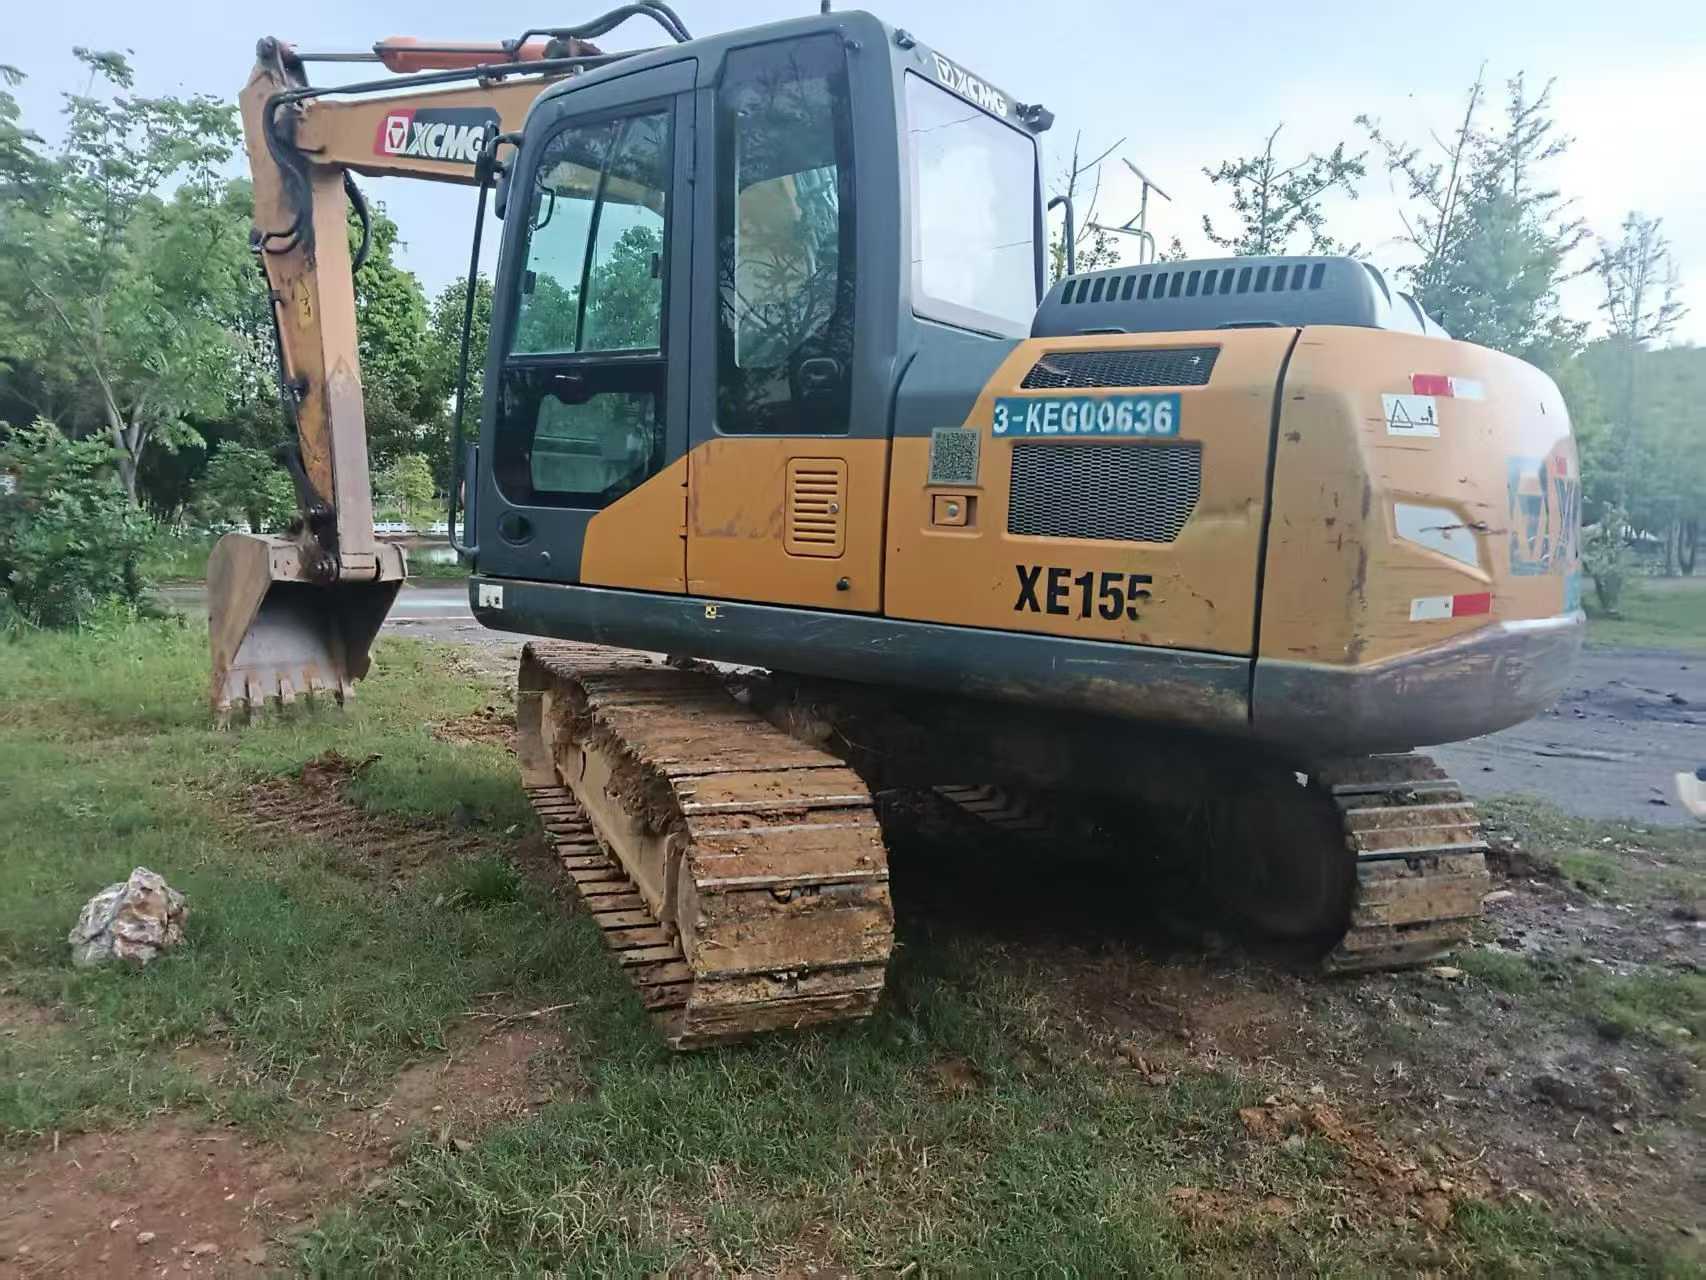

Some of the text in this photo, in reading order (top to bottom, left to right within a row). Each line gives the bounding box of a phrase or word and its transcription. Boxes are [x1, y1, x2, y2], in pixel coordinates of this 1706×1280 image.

[951, 66, 1008, 117] XCMG
[407, 122, 486, 162] XCMG
[993, 401, 1173, 433] 3-KEG00636
[1014, 564, 1153, 621] XE155
